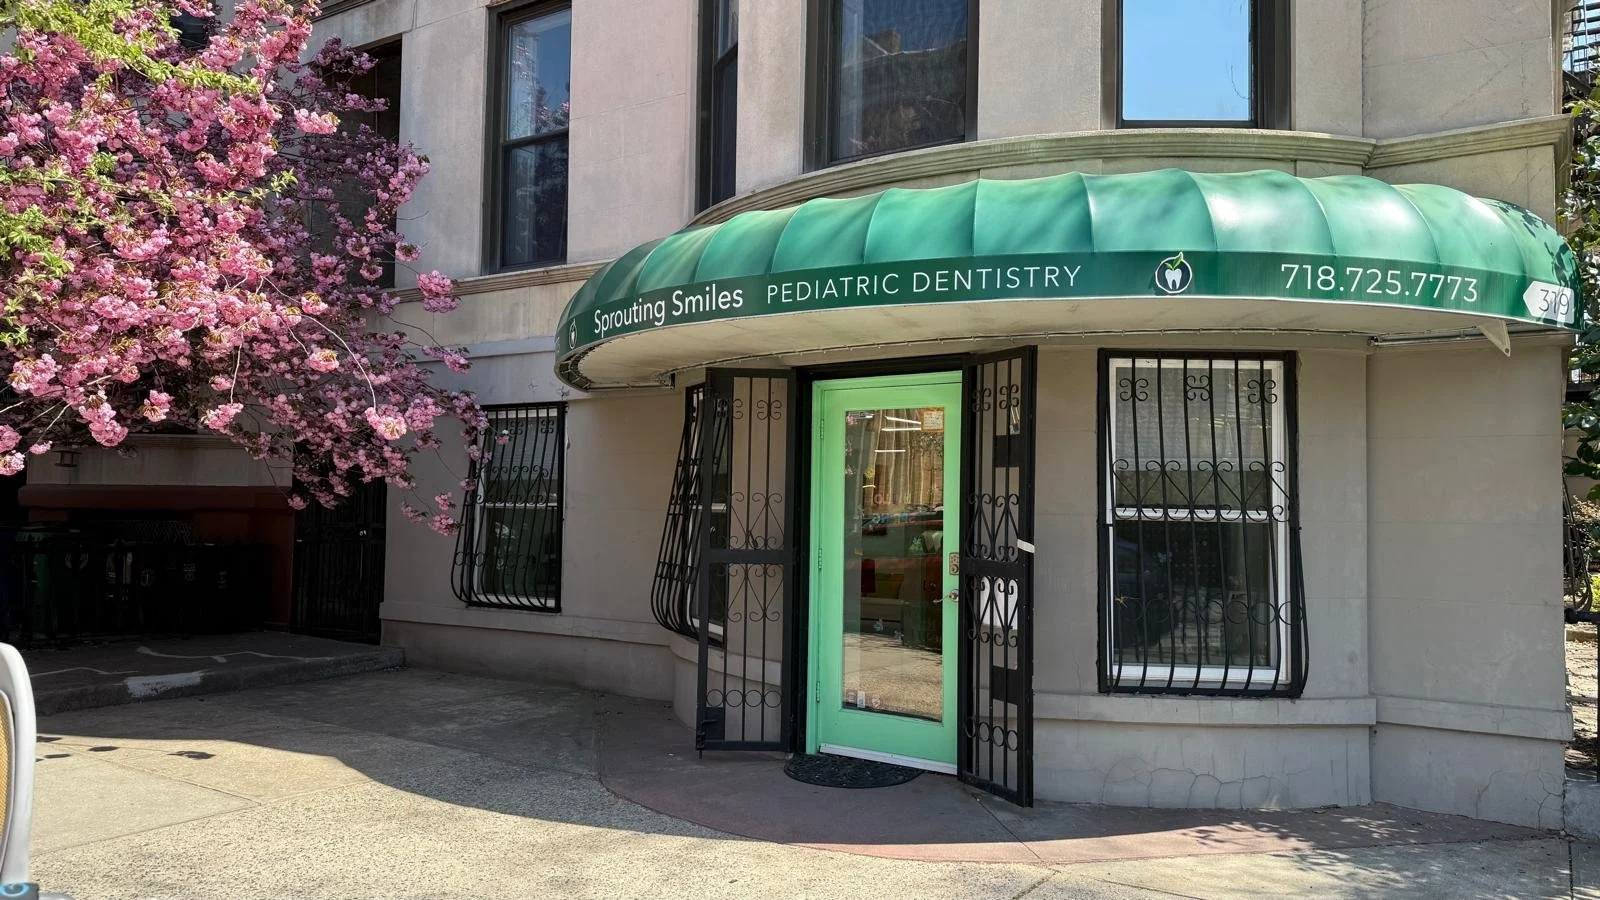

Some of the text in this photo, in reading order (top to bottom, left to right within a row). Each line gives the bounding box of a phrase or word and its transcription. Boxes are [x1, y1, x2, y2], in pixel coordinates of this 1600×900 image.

[594, 265, 1081, 338] Sprouting Smiles PEDIATRIC DENTISTRY
[1281, 264, 1478, 302] 718.725.7773
[1538, 289, 1570, 315] 319
